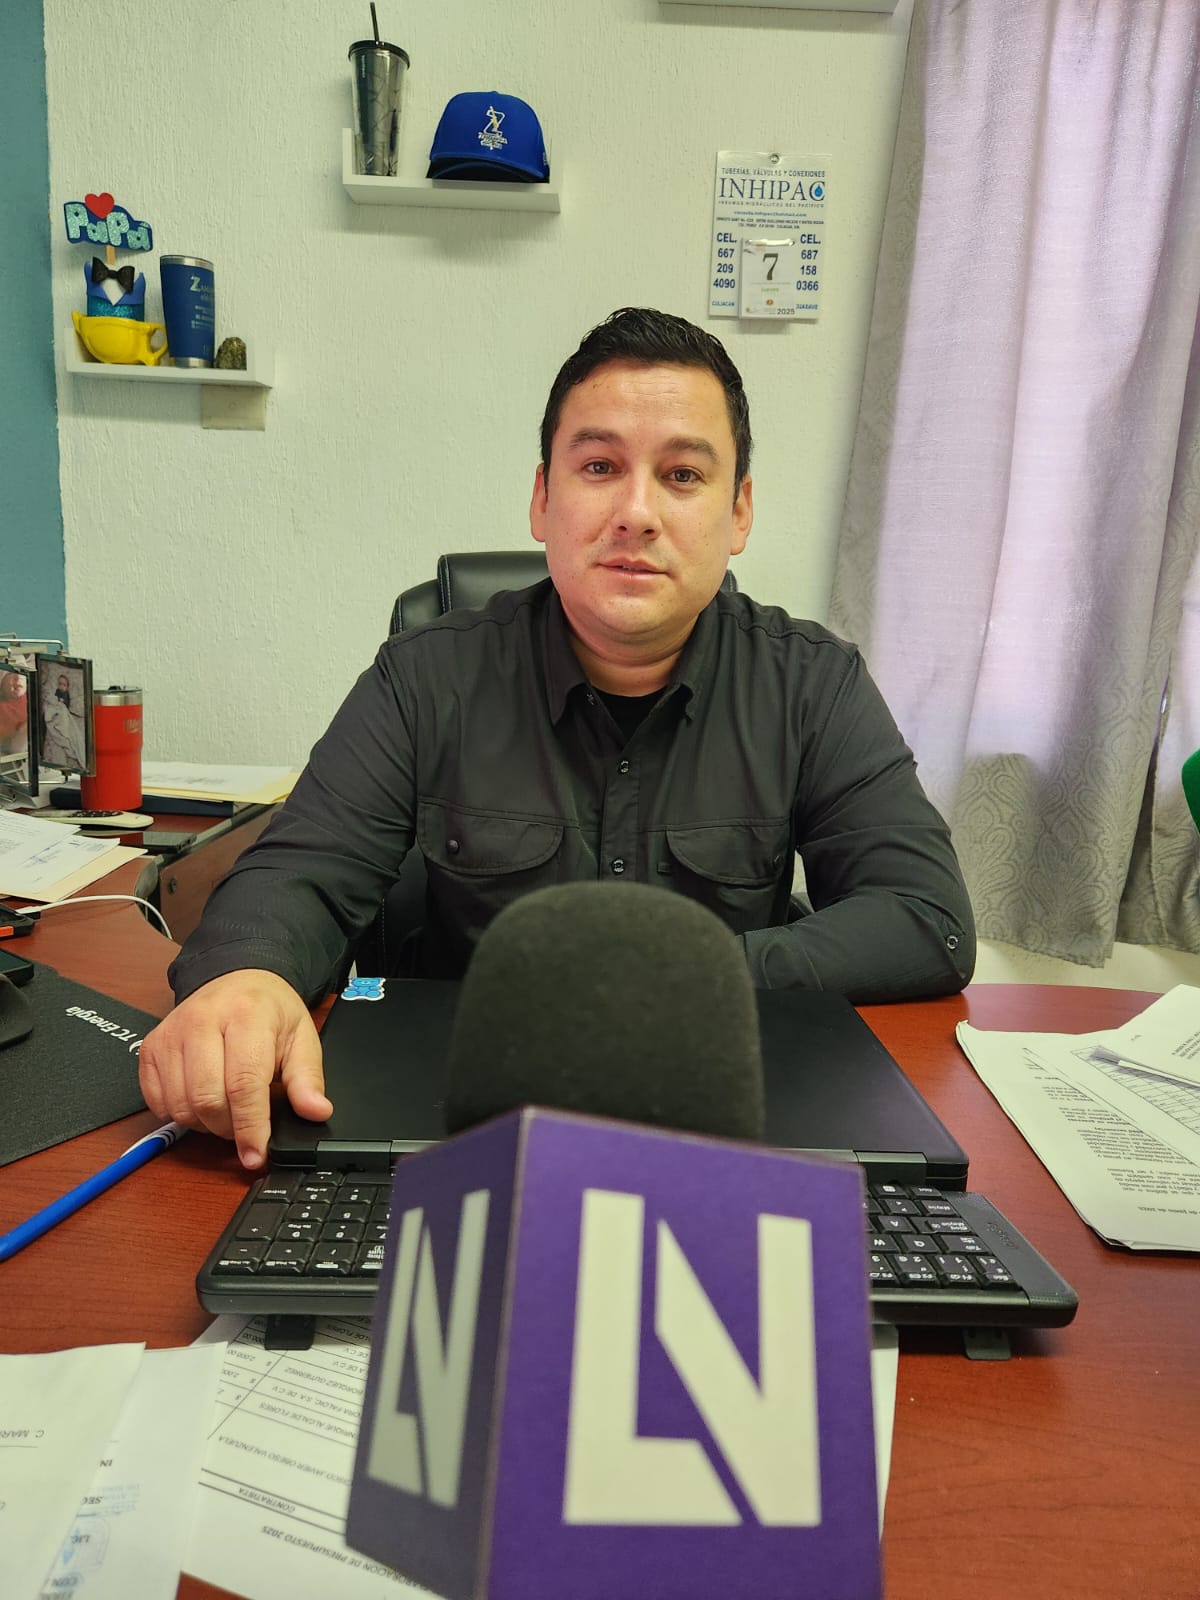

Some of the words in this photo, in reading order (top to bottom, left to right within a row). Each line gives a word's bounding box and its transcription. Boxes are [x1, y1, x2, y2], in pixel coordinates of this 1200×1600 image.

[788, 169, 825, 178] CONEXIONES
[719, 177, 826, 202] INHIPAC
[716, 232, 738, 243] CEL.
[800, 233, 822, 245] CEL.
[717, 248, 735, 258] 667
[801, 249, 819, 260] 687
[716, 262, 734, 274] 209
[762, 252, 779, 281] 7
[800, 264, 817, 276] 158
[712, 278, 736, 289] 4090
[796, 280, 819, 291] 0366
[65, 1006, 121, 1033] Energía
[111, 1028, 138, 1042] TC
[913, 1240, 925, 1248] Q
[260, 1524, 283, 1541] 2025
[349, 1554, 363, 1568] DE
